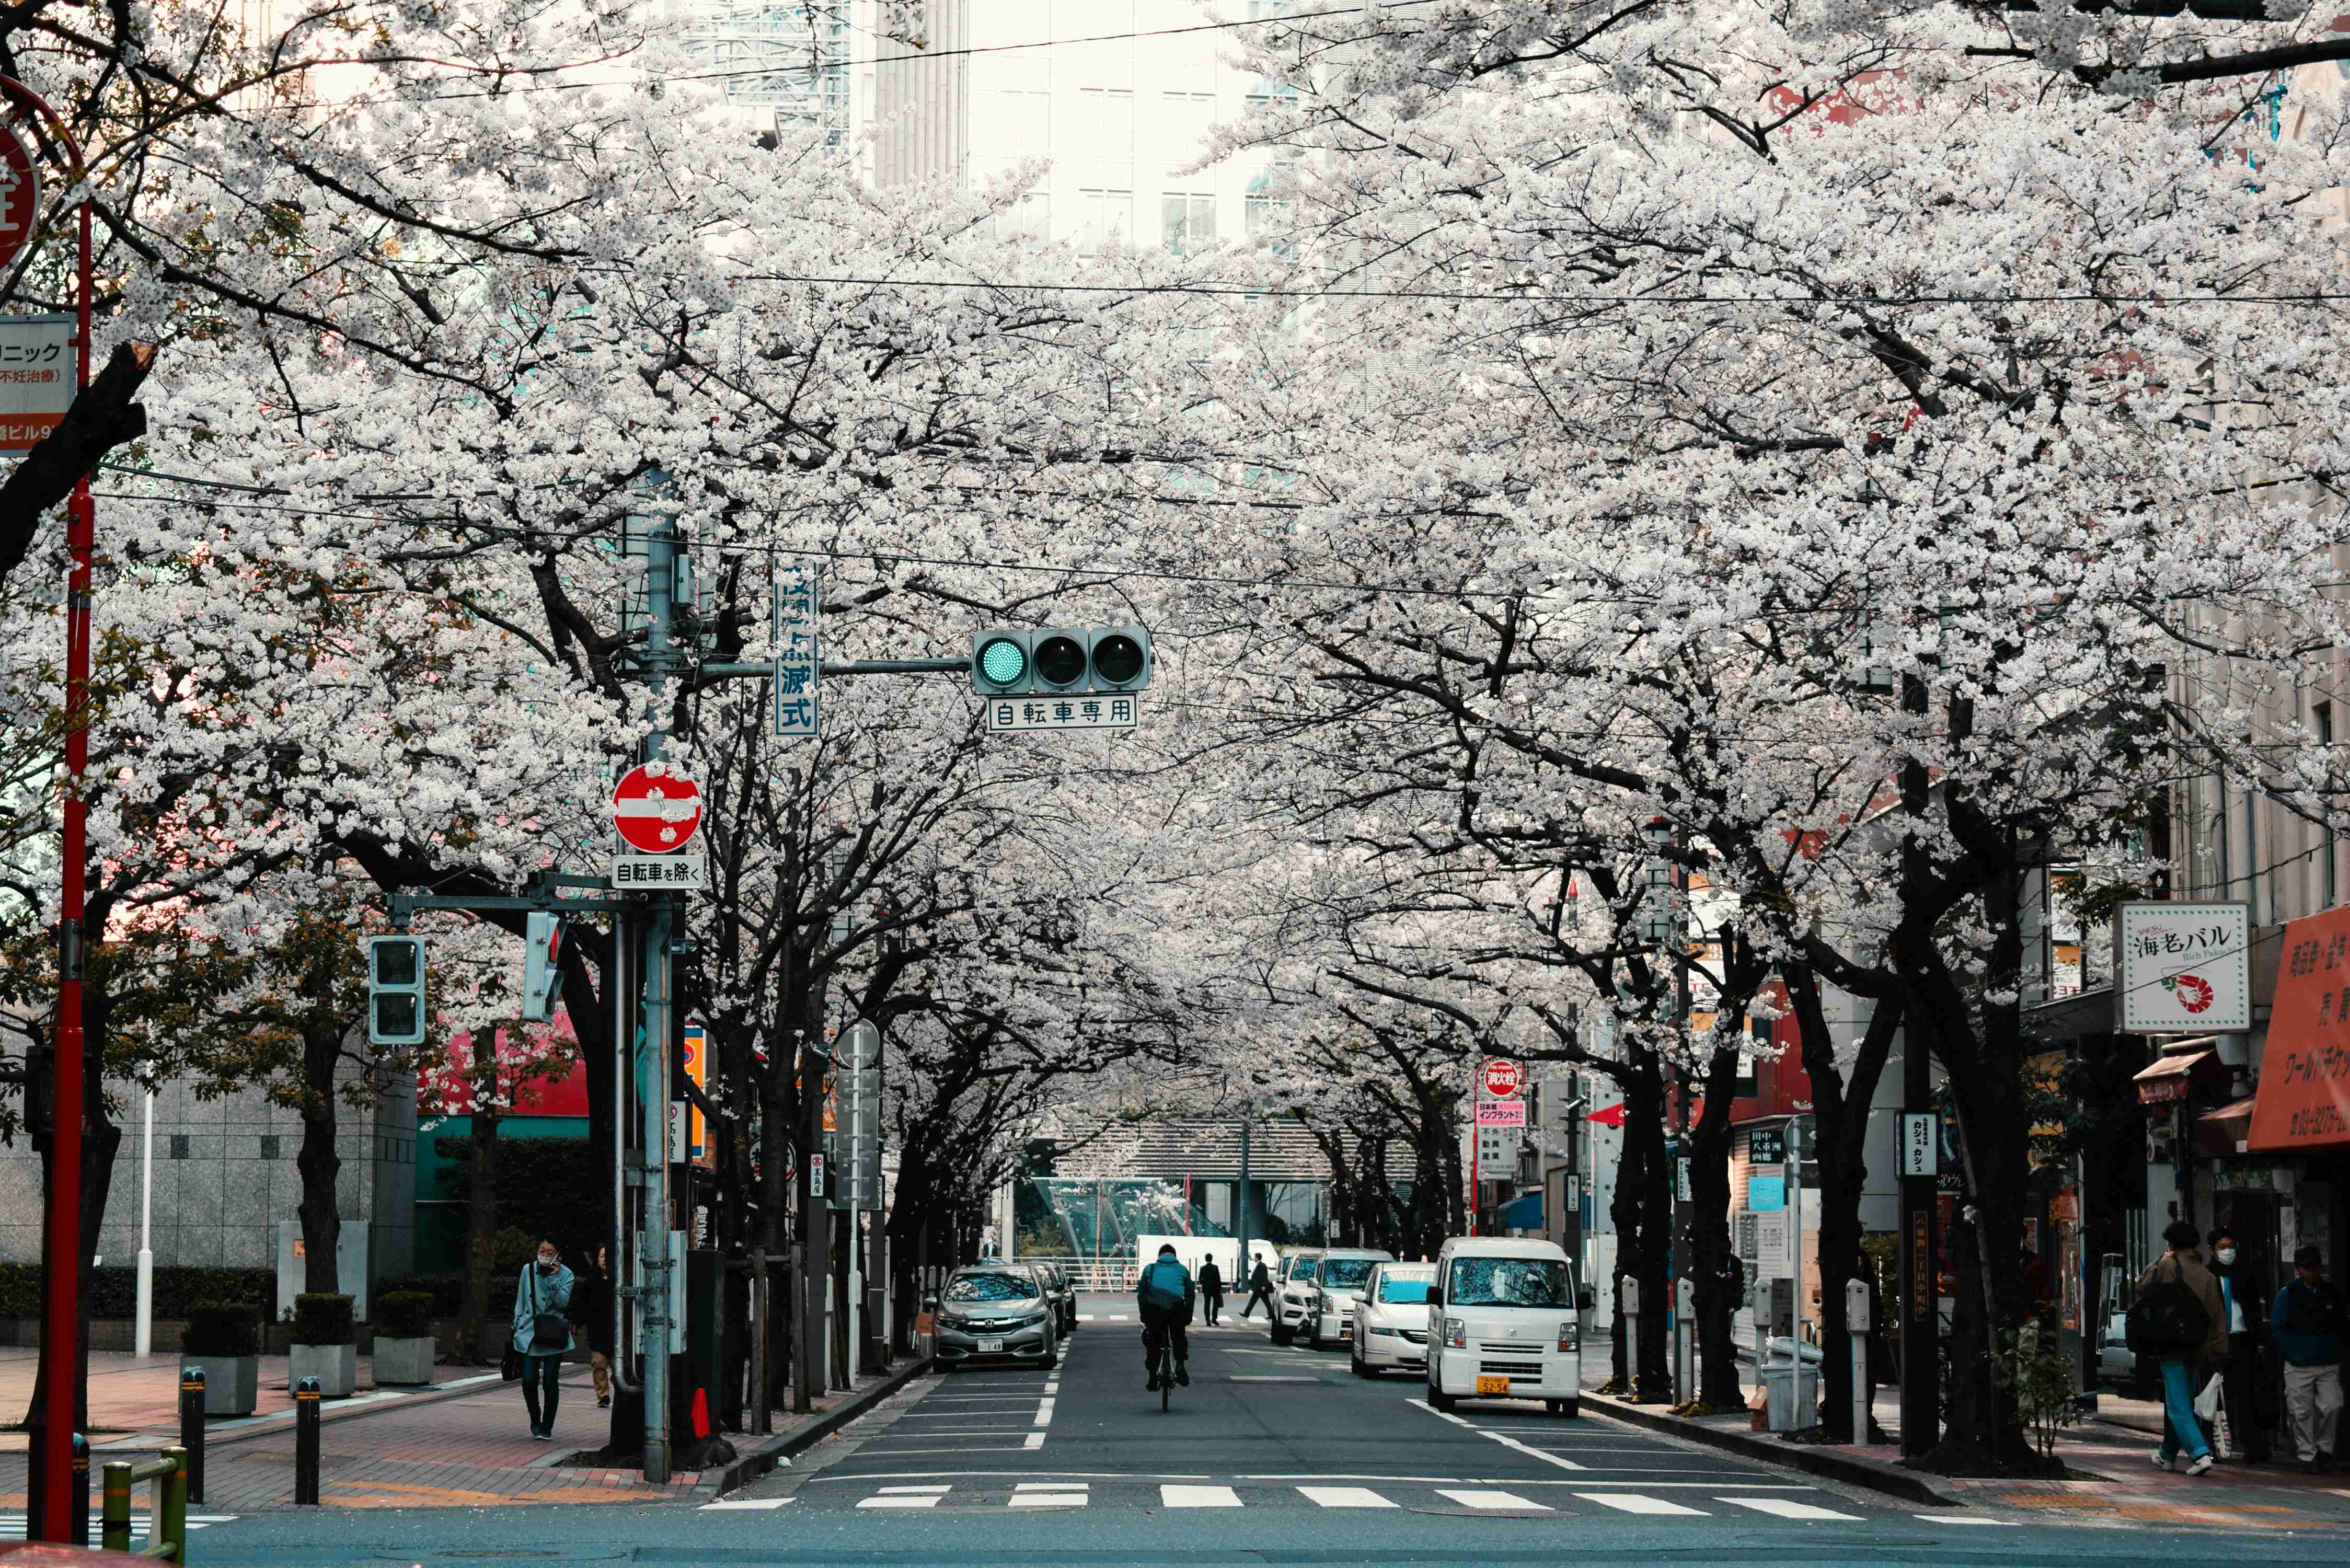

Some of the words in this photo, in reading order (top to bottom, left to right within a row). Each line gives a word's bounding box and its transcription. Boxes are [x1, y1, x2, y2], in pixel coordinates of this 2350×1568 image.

[0, 343, 60, 362] ニック
[0, 425, 55, 440] ビル9
[997, 700, 1130, 725] 自転車専用
[618, 862, 699, 882] 自転車を除く
[2134, 926, 2232, 958] 海老バル
[2183, 951, 2202, 962] Rich
[1488, 1071, 1516, 1086] 消火栓
[1752, 1132, 1771, 1141] 田中
[1753, 1142, 1782, 1151] 八重洲
[1484, 1382, 1507, 1392] 52-54
